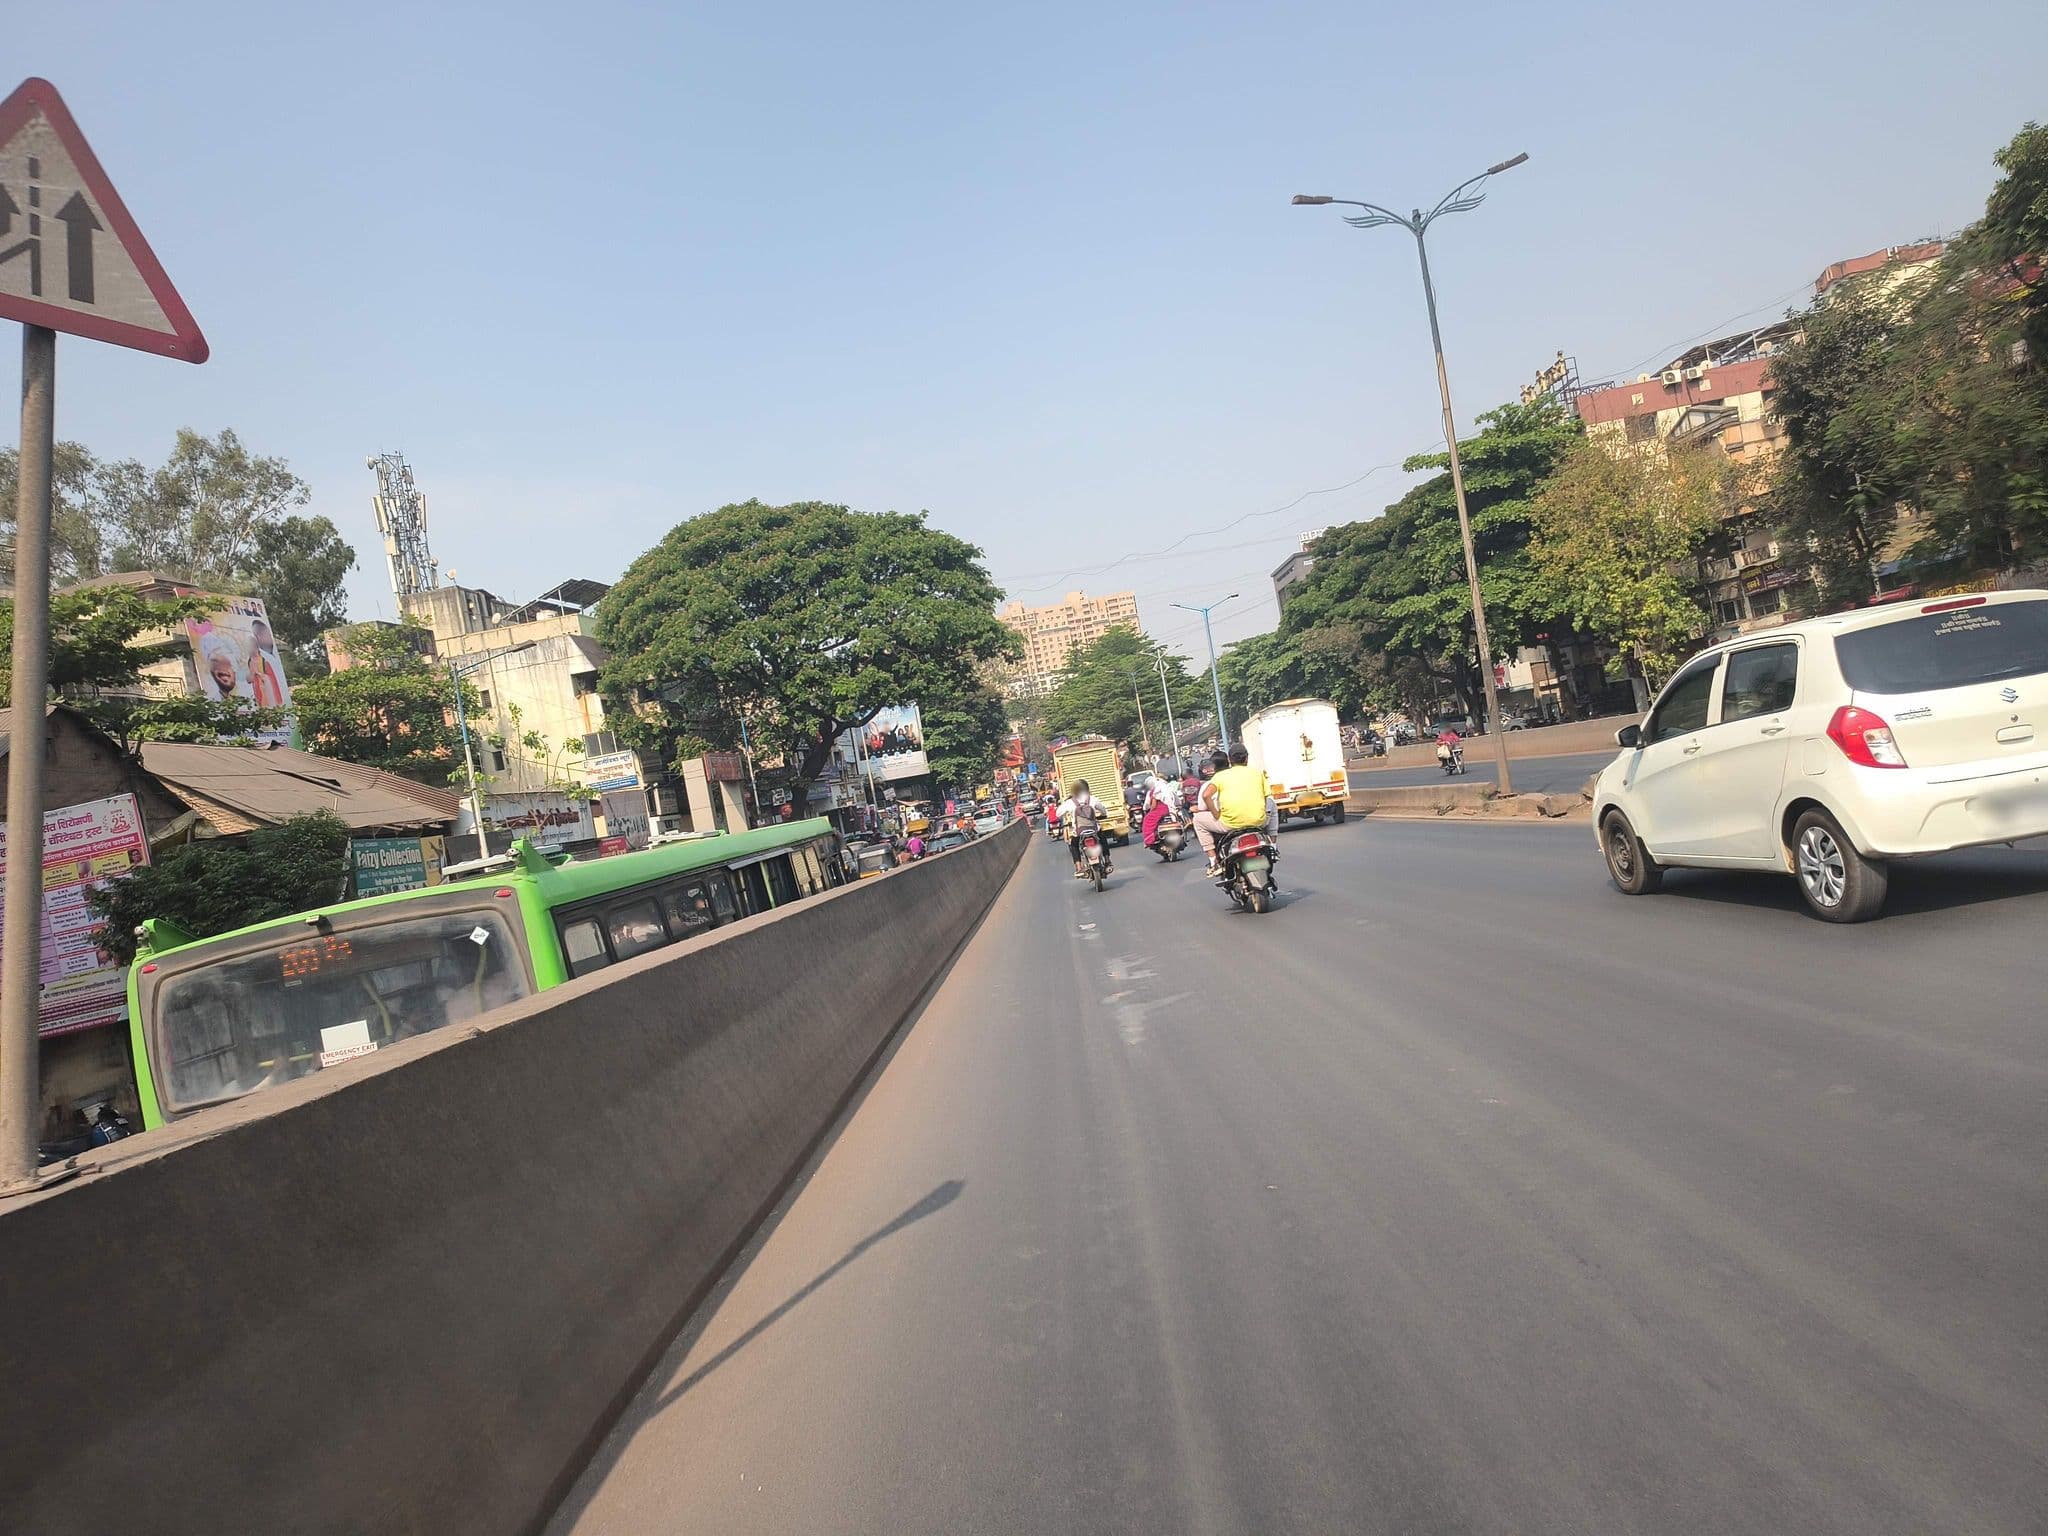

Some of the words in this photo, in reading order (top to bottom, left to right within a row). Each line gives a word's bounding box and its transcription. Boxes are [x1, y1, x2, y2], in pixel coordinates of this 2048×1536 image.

[57, 812, 93, 830] शिरोमणी
[356, 850, 379, 869] Faizy
[380, 847, 422, 867] Collection
[322, 1046, 361, 1060] EMERGENCY
[362, 1043, 376, 1052] EXIT
